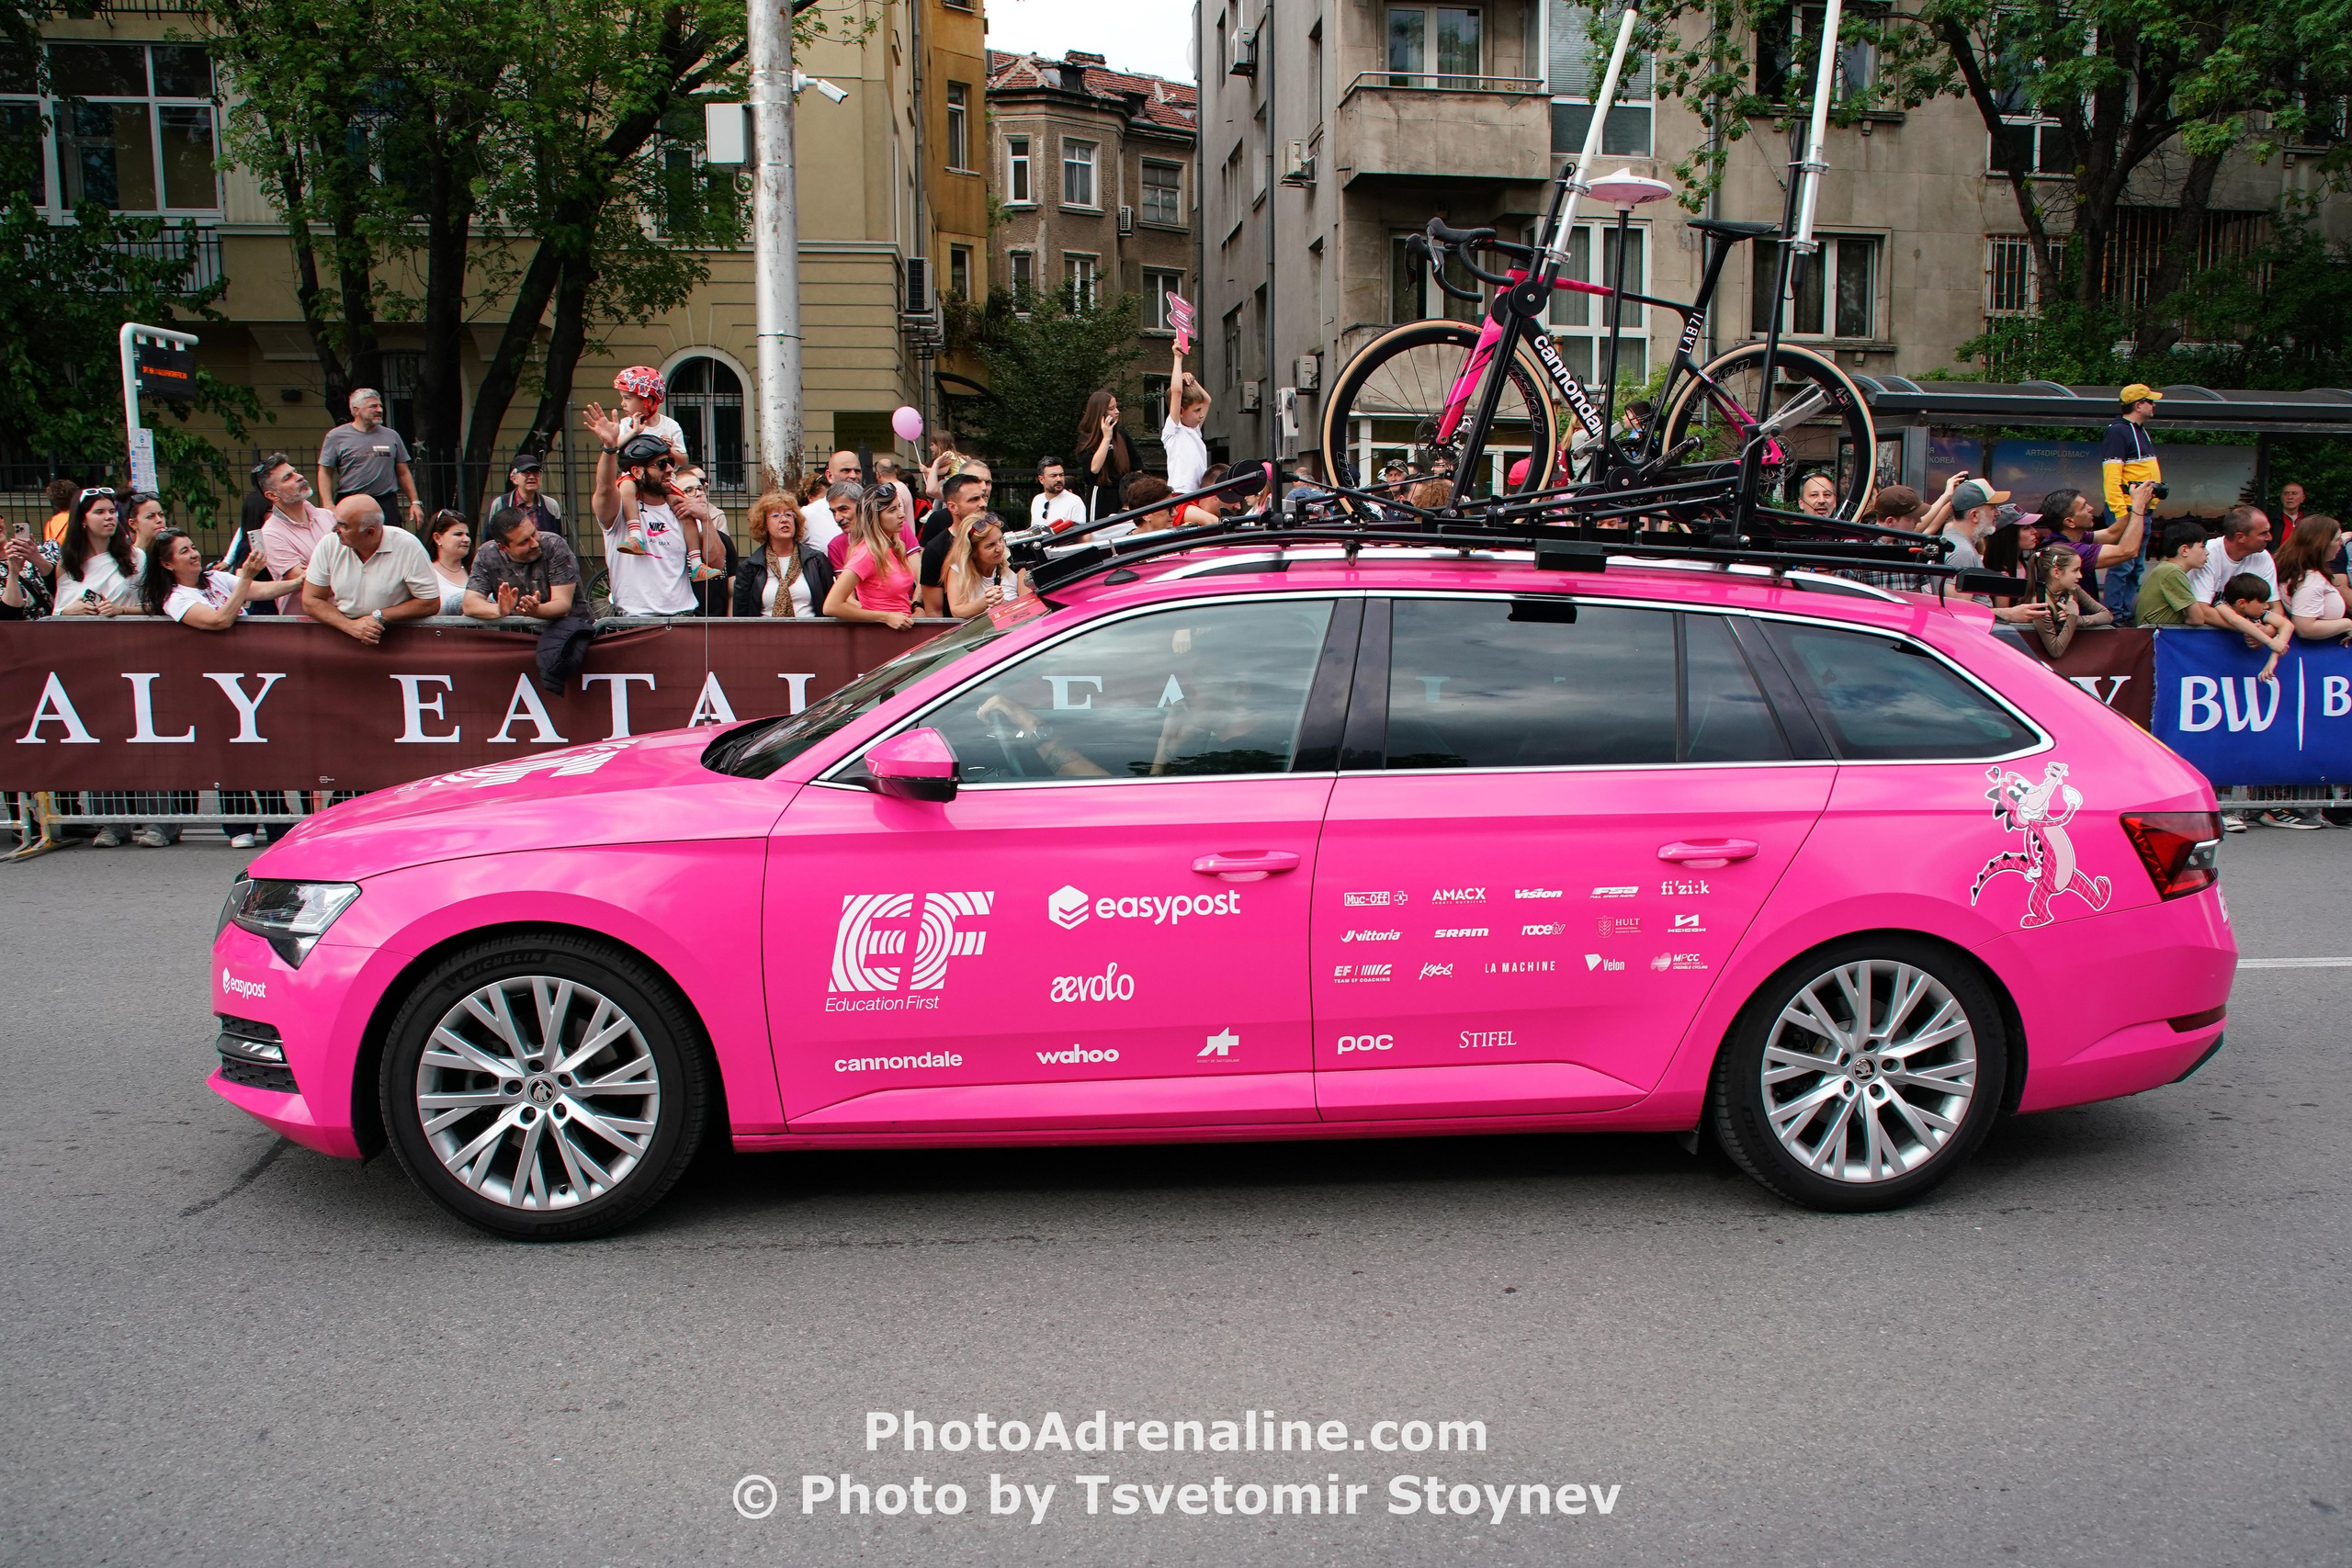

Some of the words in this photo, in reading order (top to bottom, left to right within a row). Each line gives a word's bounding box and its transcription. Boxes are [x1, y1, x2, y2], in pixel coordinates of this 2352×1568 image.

[1679, 312, 1703, 354] LAB71
[1533, 335, 1603, 434] cannondal
[2026, 449, 2090, 458] ART4DIPLOMACY
[649, 522, 666, 532] NIKE
[2179, 675, 2280, 732] BW
[1346, 894, 1388, 905] Muc-Off
[1431, 887, 1486, 901] AMACX
[1514, 888, 1563, 899] Vision
[1095, 889, 1240, 926] easypost
[1521, 921, 1566, 936] racetv
[1615, 918, 1640, 926] HULT
[1355, 929, 1401, 942] vittoria
[1434, 928, 1489, 938] SRAM
[827, 890, 995, 993] EF
[1603, 958, 1625, 971] Velon
[1673, 953, 1700, 962] MPCC
[462, 953, 543, 978] MICHELIN
[1334, 965, 1352, 976] EF
[1485, 963, 1497, 974] LA
[1501, 961, 1555, 973] MACHINE
[231, 976, 266, 1000] easypost
[824, 996, 904, 1012] Education
[906, 994, 941, 1010] First
[1459, 1030, 1517, 1050] STIFEL
[1035, 1043, 1120, 1065] wahoo
[834, 1050, 963, 1073] cannondale
